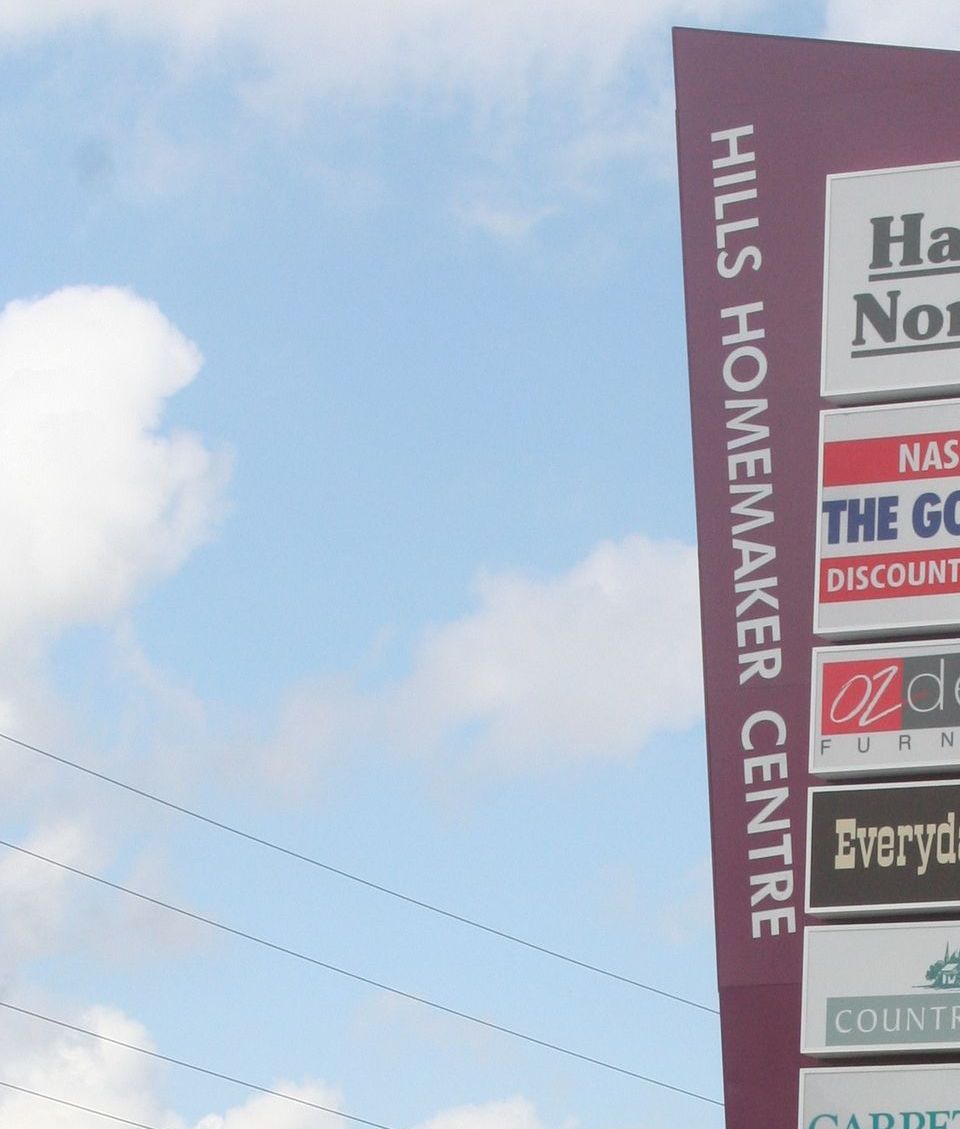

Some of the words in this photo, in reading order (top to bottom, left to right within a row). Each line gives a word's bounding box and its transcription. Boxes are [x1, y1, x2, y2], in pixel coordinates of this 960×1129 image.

[710, 124, 763, 279] HILLS
[720, 301, 783, 685] HOMEMAKER
[822, 495, 898, 545] THE
[741, 710, 796, 939] CENTRE
